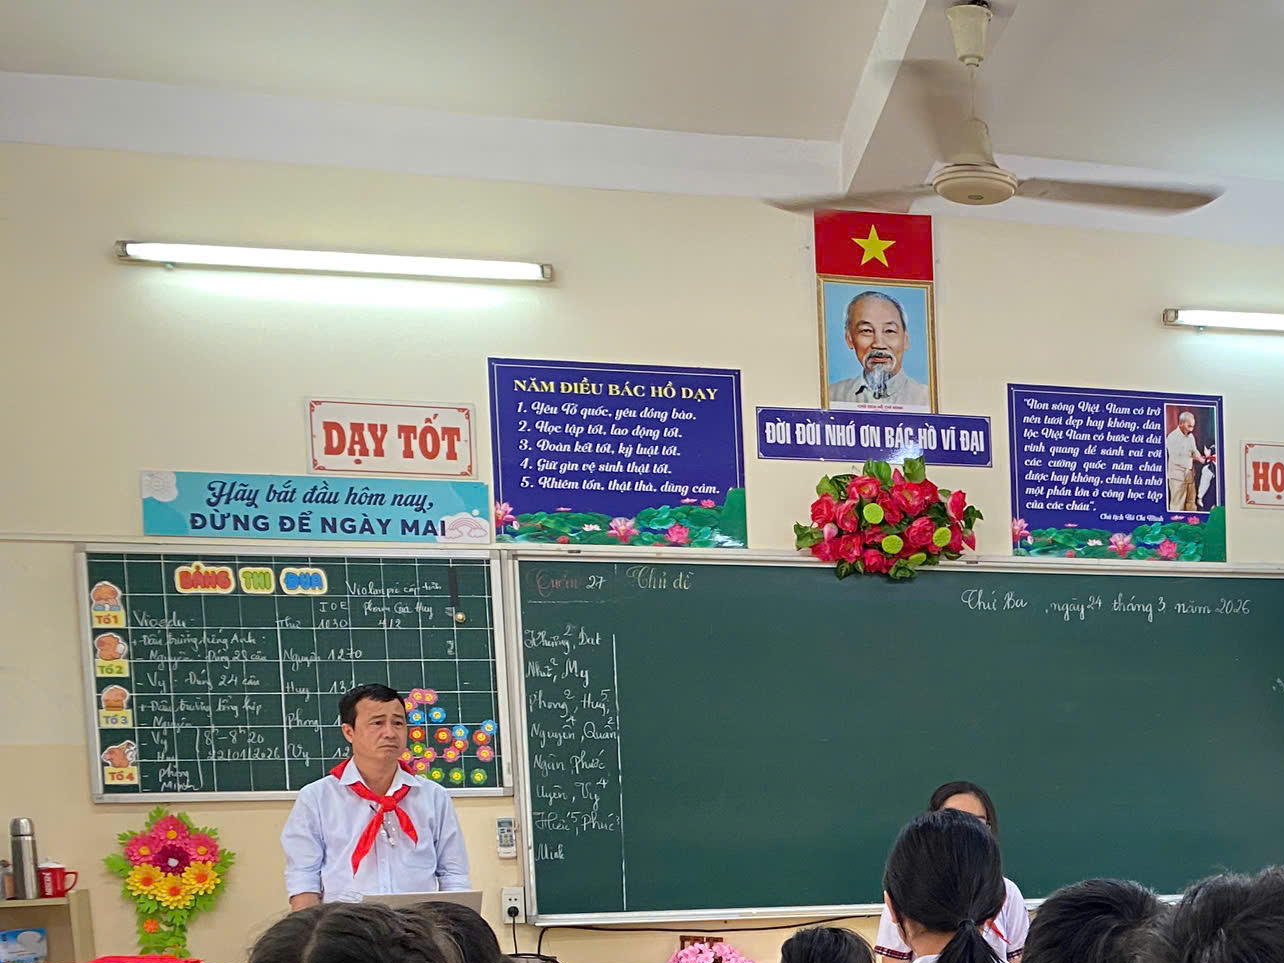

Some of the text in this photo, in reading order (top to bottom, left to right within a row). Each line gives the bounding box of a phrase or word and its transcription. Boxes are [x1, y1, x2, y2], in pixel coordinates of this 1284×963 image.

[513, 377, 718, 402] NĂM ĐIỀU BÁC HỒ DẠY
[516, 401, 696, 422] 1. Yêu Tổ quốc, yêu đồng bào.
[323, 414, 460, 464] DẠY TỐT
[518, 421, 682, 440] 2. Học tập tốt, lao động tốt.
[765, 418, 984, 455] ĐỜI ĐỜI NHỚ ƠN BÁC HỒ VĨ ĐẠI
[519, 440, 532, 450] 3.
[536, 439, 570, 452] Đoàn
[574, 441, 593, 453] kết
[595, 442, 614, 455] tốt,
[636, 444, 659, 457] luật
[662, 445, 680, 457] tốt.
[520, 458, 672, 474] 4. Giữ gìn vệ sinh thật tốt.
[206, 479, 433, 513] Hãy bắt đầu hôm nay,
[190, 510, 445, 536] ĐỪNG ĐỂ NGÀY MAI
[179, 565, 322, 589] BẢNG THI ĐUA
[586, 576, 606, 589] 27
[1087, 595, 1101, 609] 24
